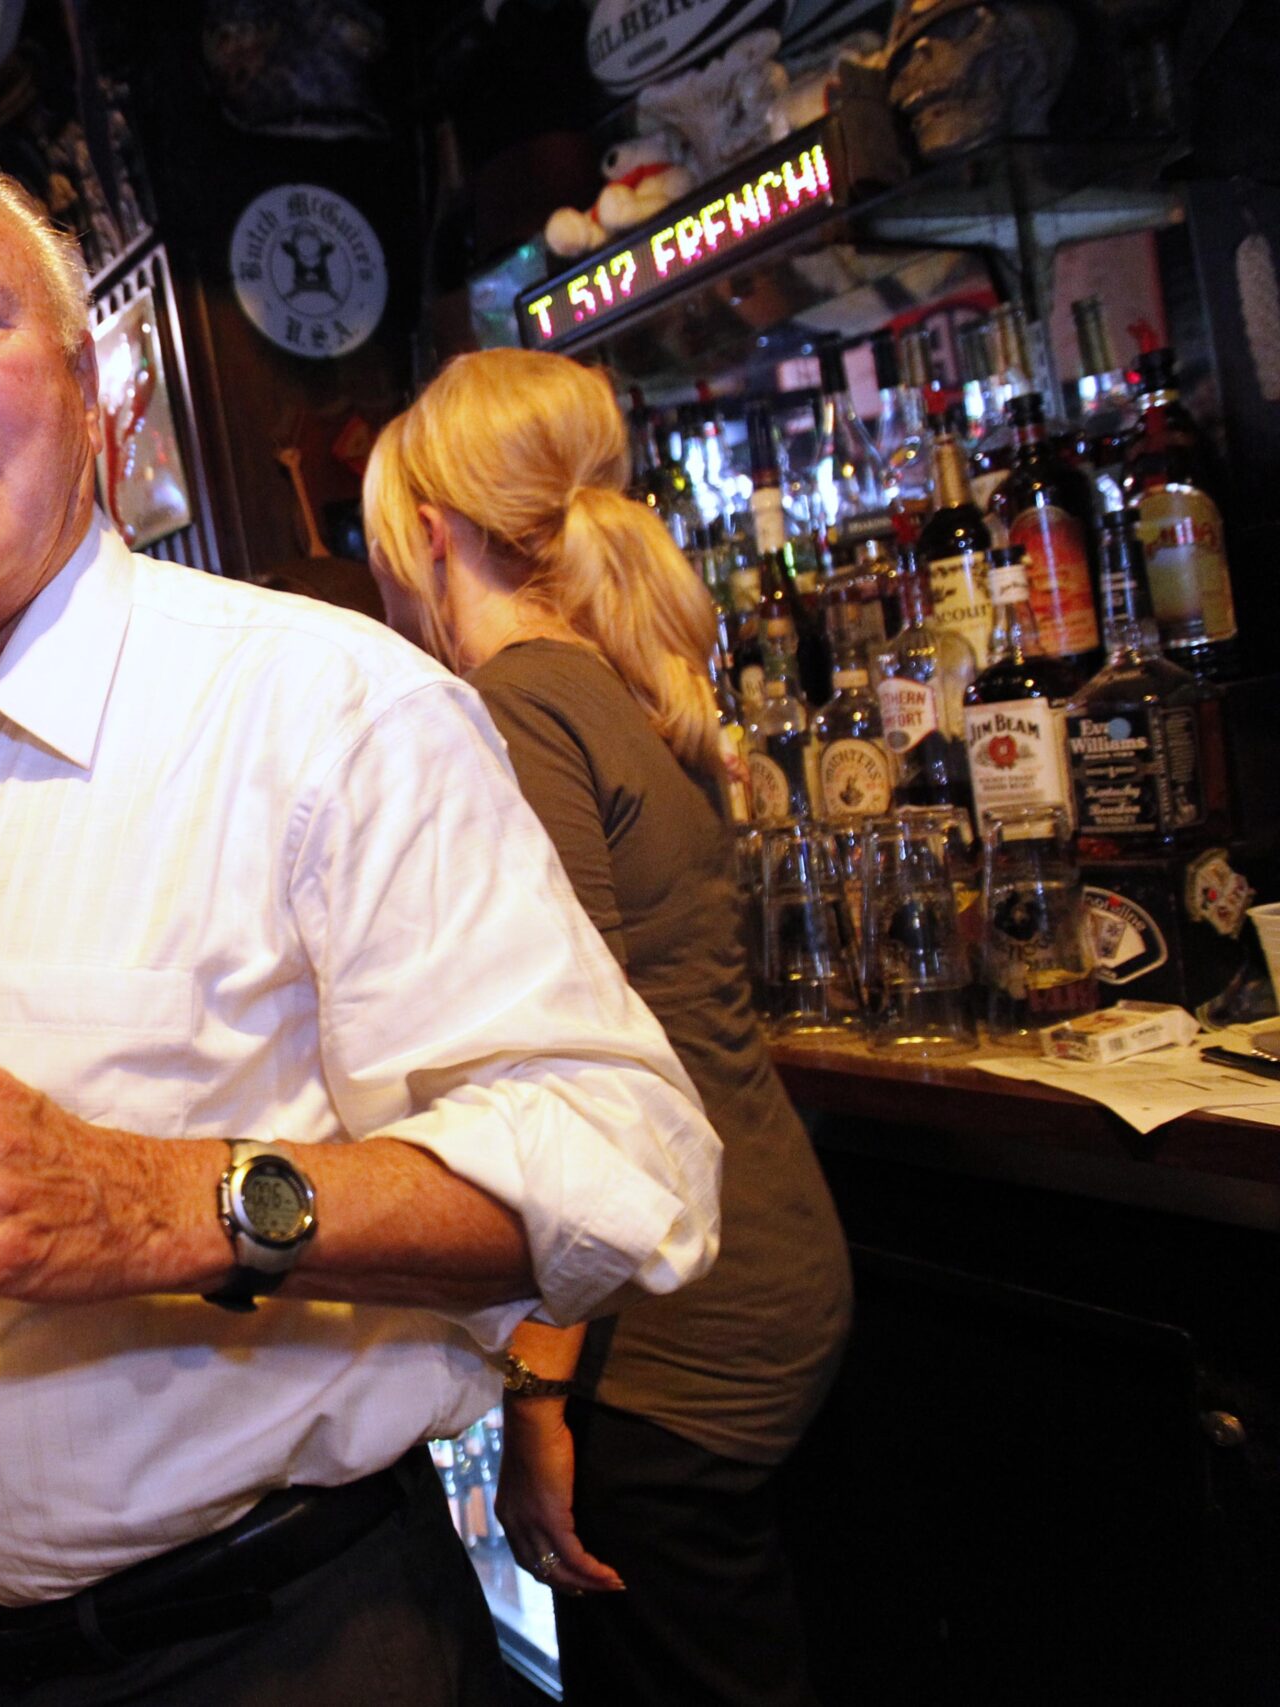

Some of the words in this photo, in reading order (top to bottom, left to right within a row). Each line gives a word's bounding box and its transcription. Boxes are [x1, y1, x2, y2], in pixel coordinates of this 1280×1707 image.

[566, 252, 637, 323] 517
[969, 721, 991, 747] JIM
[995, 713, 1039, 739] BEAM
[1069, 736, 1148, 755] Williams
